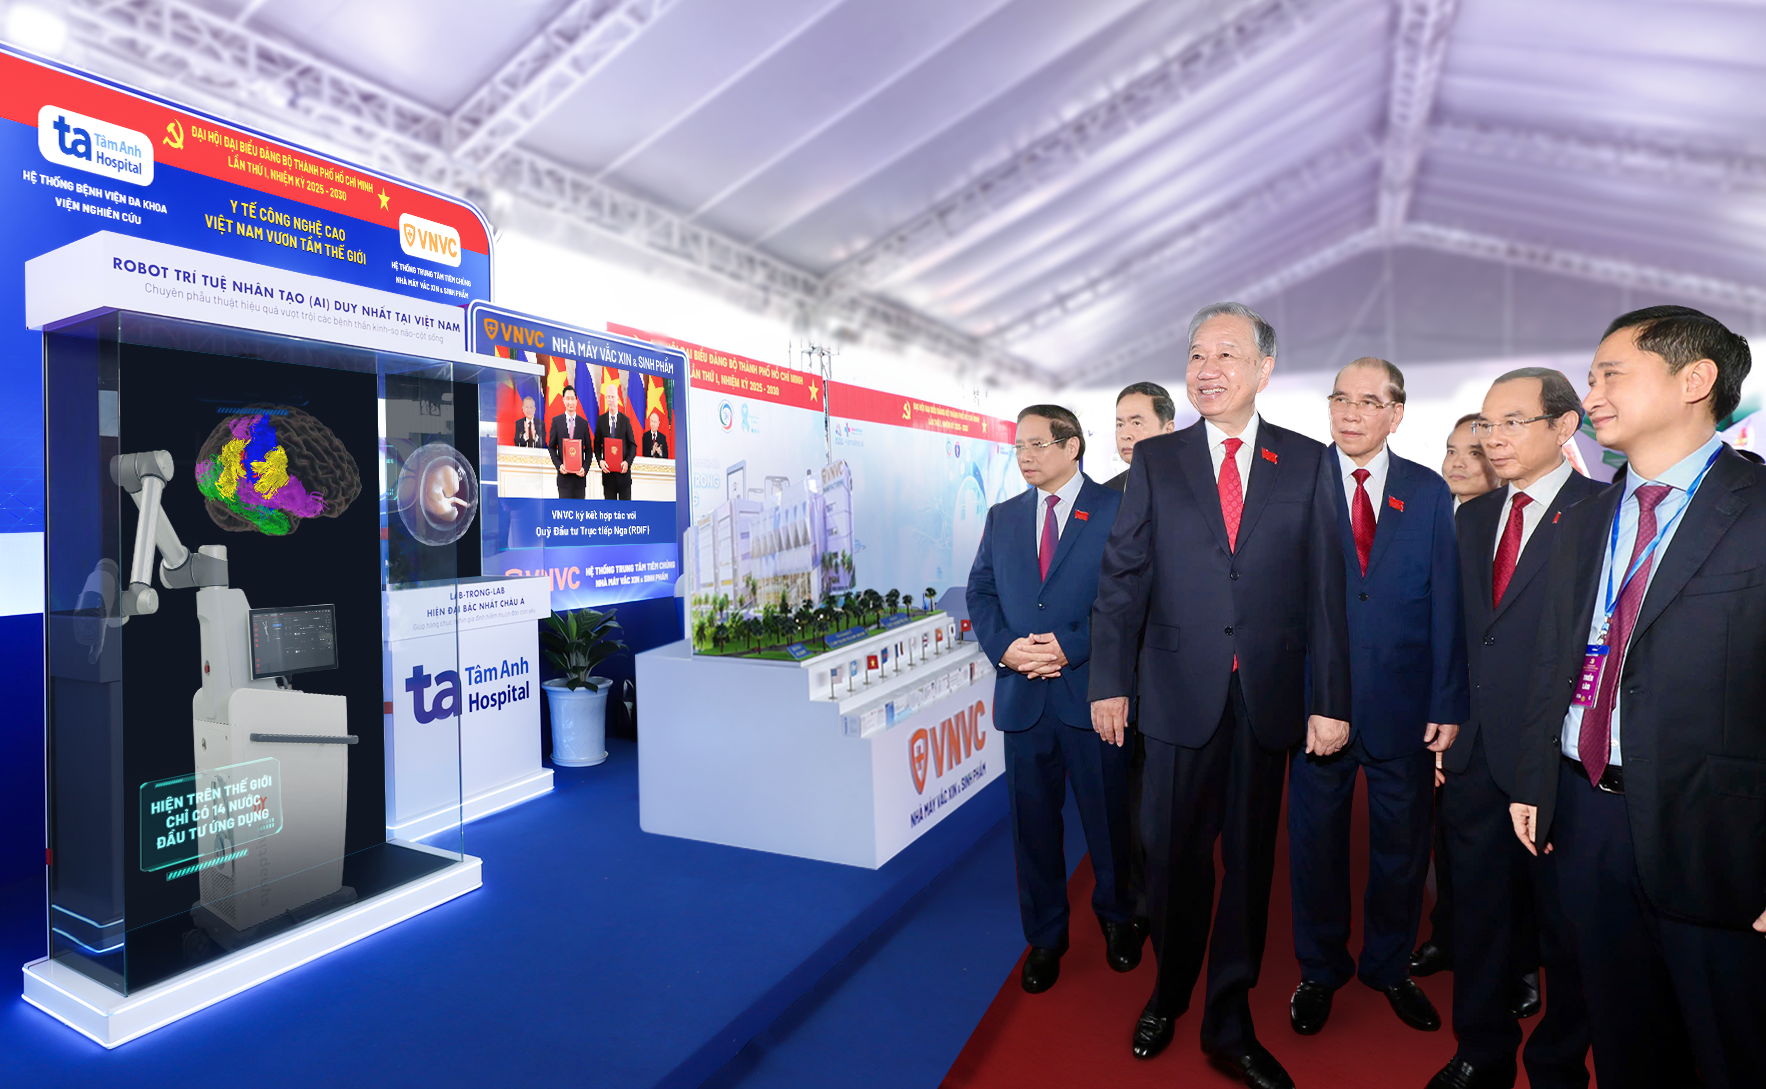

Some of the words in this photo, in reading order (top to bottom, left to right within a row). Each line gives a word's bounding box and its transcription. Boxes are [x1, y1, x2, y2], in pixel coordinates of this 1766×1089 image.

[53, 115, 92, 161] ta
[94, 132, 118, 151] Tâm
[119, 137, 142, 158] Anh
[96, 151, 142, 175] Hospital
[191, 126, 206, 142] ĐẠI
[208, 130, 222, 146] HỘI
[224, 135, 238, 151] ĐẠI
[240, 137, 258, 156] BIỂU
[260, 144, 281, 164] ĐẢNG
[282, 152, 293, 170] BỘ
[294, 156, 318, 175] THÀNH
[320, 162, 334, 180] PHỐ
[336, 167, 344, 183] HỒ
[346, 172, 357, 187] CHÍ
[359, 177, 374, 194] MINH
[228, 153, 246, 172] LẦN
[247, 159, 264, 178] THỨ
[271, 166, 294, 187] NHIỆM
[295, 172, 306, 190] KỲ
[306, 180, 325, 197] 2025
[330, 186, 347, 202] 2030
[23, 170, 38, 184] HỆ
[40, 171, 74, 191] THỐNG
[76, 181, 103, 199] BỆNH
[104, 188, 127, 205] VIỆN
[143, 200, 168, 214] KHOA
[55, 196, 80, 211] VIỆN
[82, 203, 120, 221] NGHIÊN
[122, 209, 142, 225] CỨU
[204, 213, 233, 235] VIỆT
[236, 222, 263, 242] NAM
[266, 230, 298, 251] VƯƠN
[300, 231, 323, 255] TẦM
[325, 239, 345, 260] THẾ
[347, 247, 367, 266] GIỚI
[229, 199, 239, 214] Y
[241, 200, 257, 219] TẾ
[259, 206, 291, 228] CÔNG
[293, 215, 323, 238] NGHỆ
[325, 225, 346, 242] CAO
[417, 228, 457, 258] VNVC
[113, 257, 169, 278] ROBOT
[174, 269, 196, 284] TRÍ
[202, 274, 227, 293] TUỆ
[232, 280, 274, 299] NHÂN
[279, 289, 305, 304] TẠO
[309, 295, 330, 311] (AI)
[335, 300, 357, 314] DUY
[362, 304, 391, 320] NHẤT
[395, 312, 411, 325] TẠI
[414, 315, 434, 330] VIỆT
[438, 320, 461, 332] NAM
[145, 282, 184, 299] Chuyên
[214, 295, 239, 308] thuật
[241, 300, 260, 312] hiệu
[262, 305, 278, 315] quả
[281, 307, 299, 319] vượt
[302, 311, 316, 321] trội
[317, 314, 332, 324] các
[333, 316, 352, 328] bệnh
[500, 322, 545, 348] VNVC
[552, 336, 576, 356] NHÀ
[577, 340, 599, 360] MÁY
[600, 343, 617, 364] VẮC
[618, 352, 632, 366] XIN
[632, 359, 638, 368] &
[638, 356, 655, 371] SINH
[655, 357, 674, 375] PHẨM
[694, 346, 708, 363] BIỂU
[709, 351, 728, 368] ĐẢNG
[728, 357, 738, 372] BỘ
[738, 359, 758, 374] THÀNH
[758, 364, 771, 378] PHỐ
[780, 370, 790, 382] CHÍ
[790, 374, 804, 386] MINH
[702, 368, 714, 383] THỨ
[721, 374, 740, 390] NHIỆM
[741, 375, 749, 389] KỲ
[749, 382, 763, 393] 2025
[766, 385, 780, 396] 2030
[551, 510, 574, 520] VNVC
[575, 510, 584, 522] ký
[599, 510, 612, 522] hợp
[613, 510, 625, 520] tác
[570, 526, 579, 536] tư
[580, 526, 596, 538] Trực
[614, 526, 628, 537] Nga
[628, 525, 650, 536] (RDIF)
[427, 606, 445, 618] HIỆN
[479, 597, 499, 610] NHẤT
[500, 597, 518, 608] CHÂU
[465, 664, 498, 686] Tâm
[500, 657, 529, 679] Anh
[405, 664, 462, 724] ta
[469, 681, 530, 713] Hospital
[929, 700, 986, 779] VNVC
[151, 796, 184, 815] HIỆN
[187, 787, 221, 806] TRÊN
[224, 778, 248, 796] THẾ
[250, 775, 272, 791] GIỚI
[192, 804, 210, 821] CÓ
[212, 804, 226, 817] 14
[229, 794, 261, 813] NƯỚC
[156, 829, 185, 849] ĐẦU
[188, 823, 208, 840] TƯ
[209, 818, 235, 835] ỨNG
[238, 808, 269, 827] DỤNG
